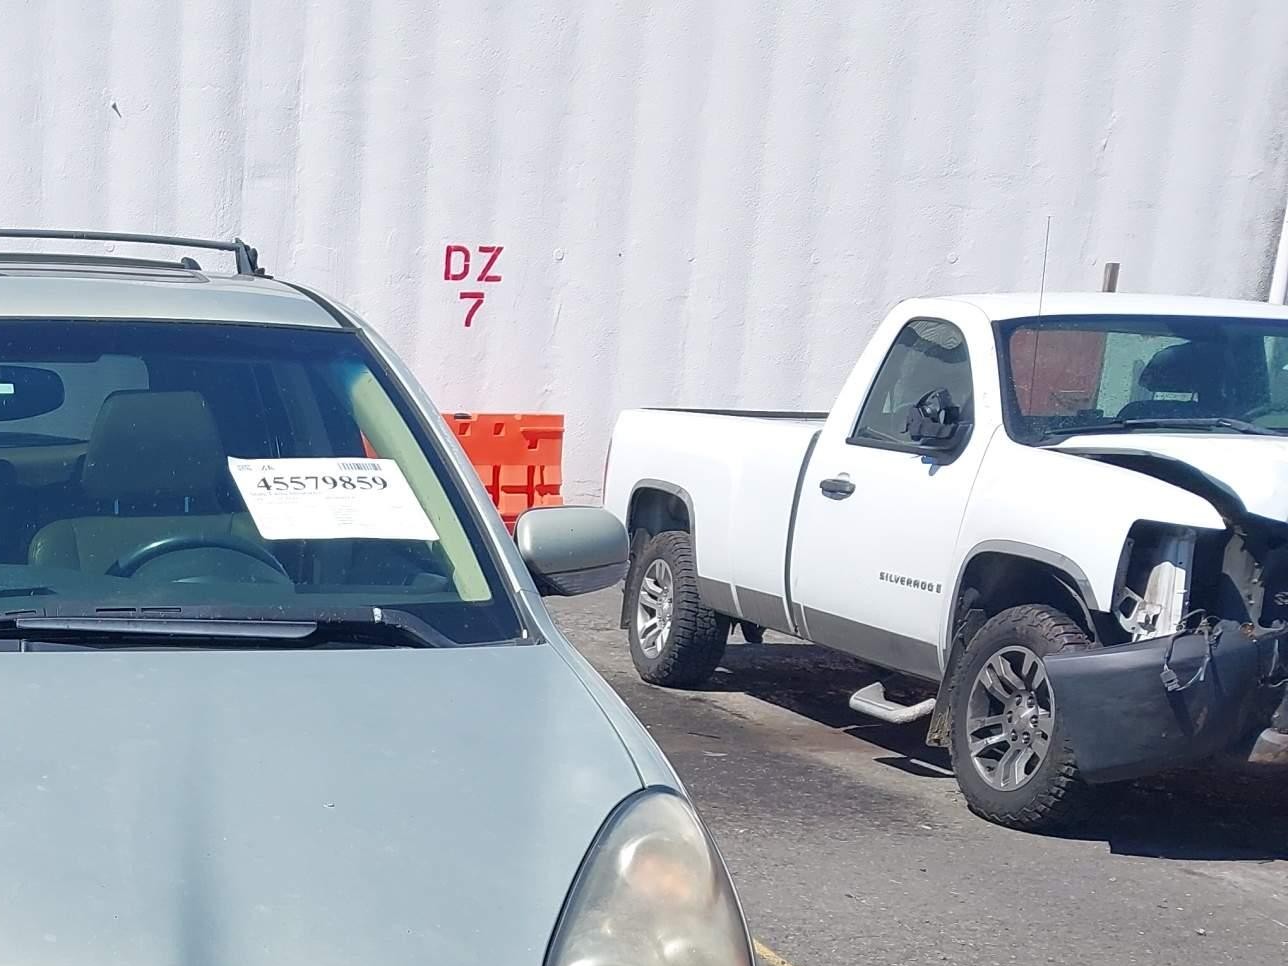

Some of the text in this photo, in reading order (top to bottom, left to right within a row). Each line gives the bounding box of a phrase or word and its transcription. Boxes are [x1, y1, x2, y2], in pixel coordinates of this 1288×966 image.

[444, 245, 503, 283] DZ
[459, 290, 485, 328] 7
[256, 475, 388, 492] 45579859
[879, 571, 934, 593] SILVERADO
